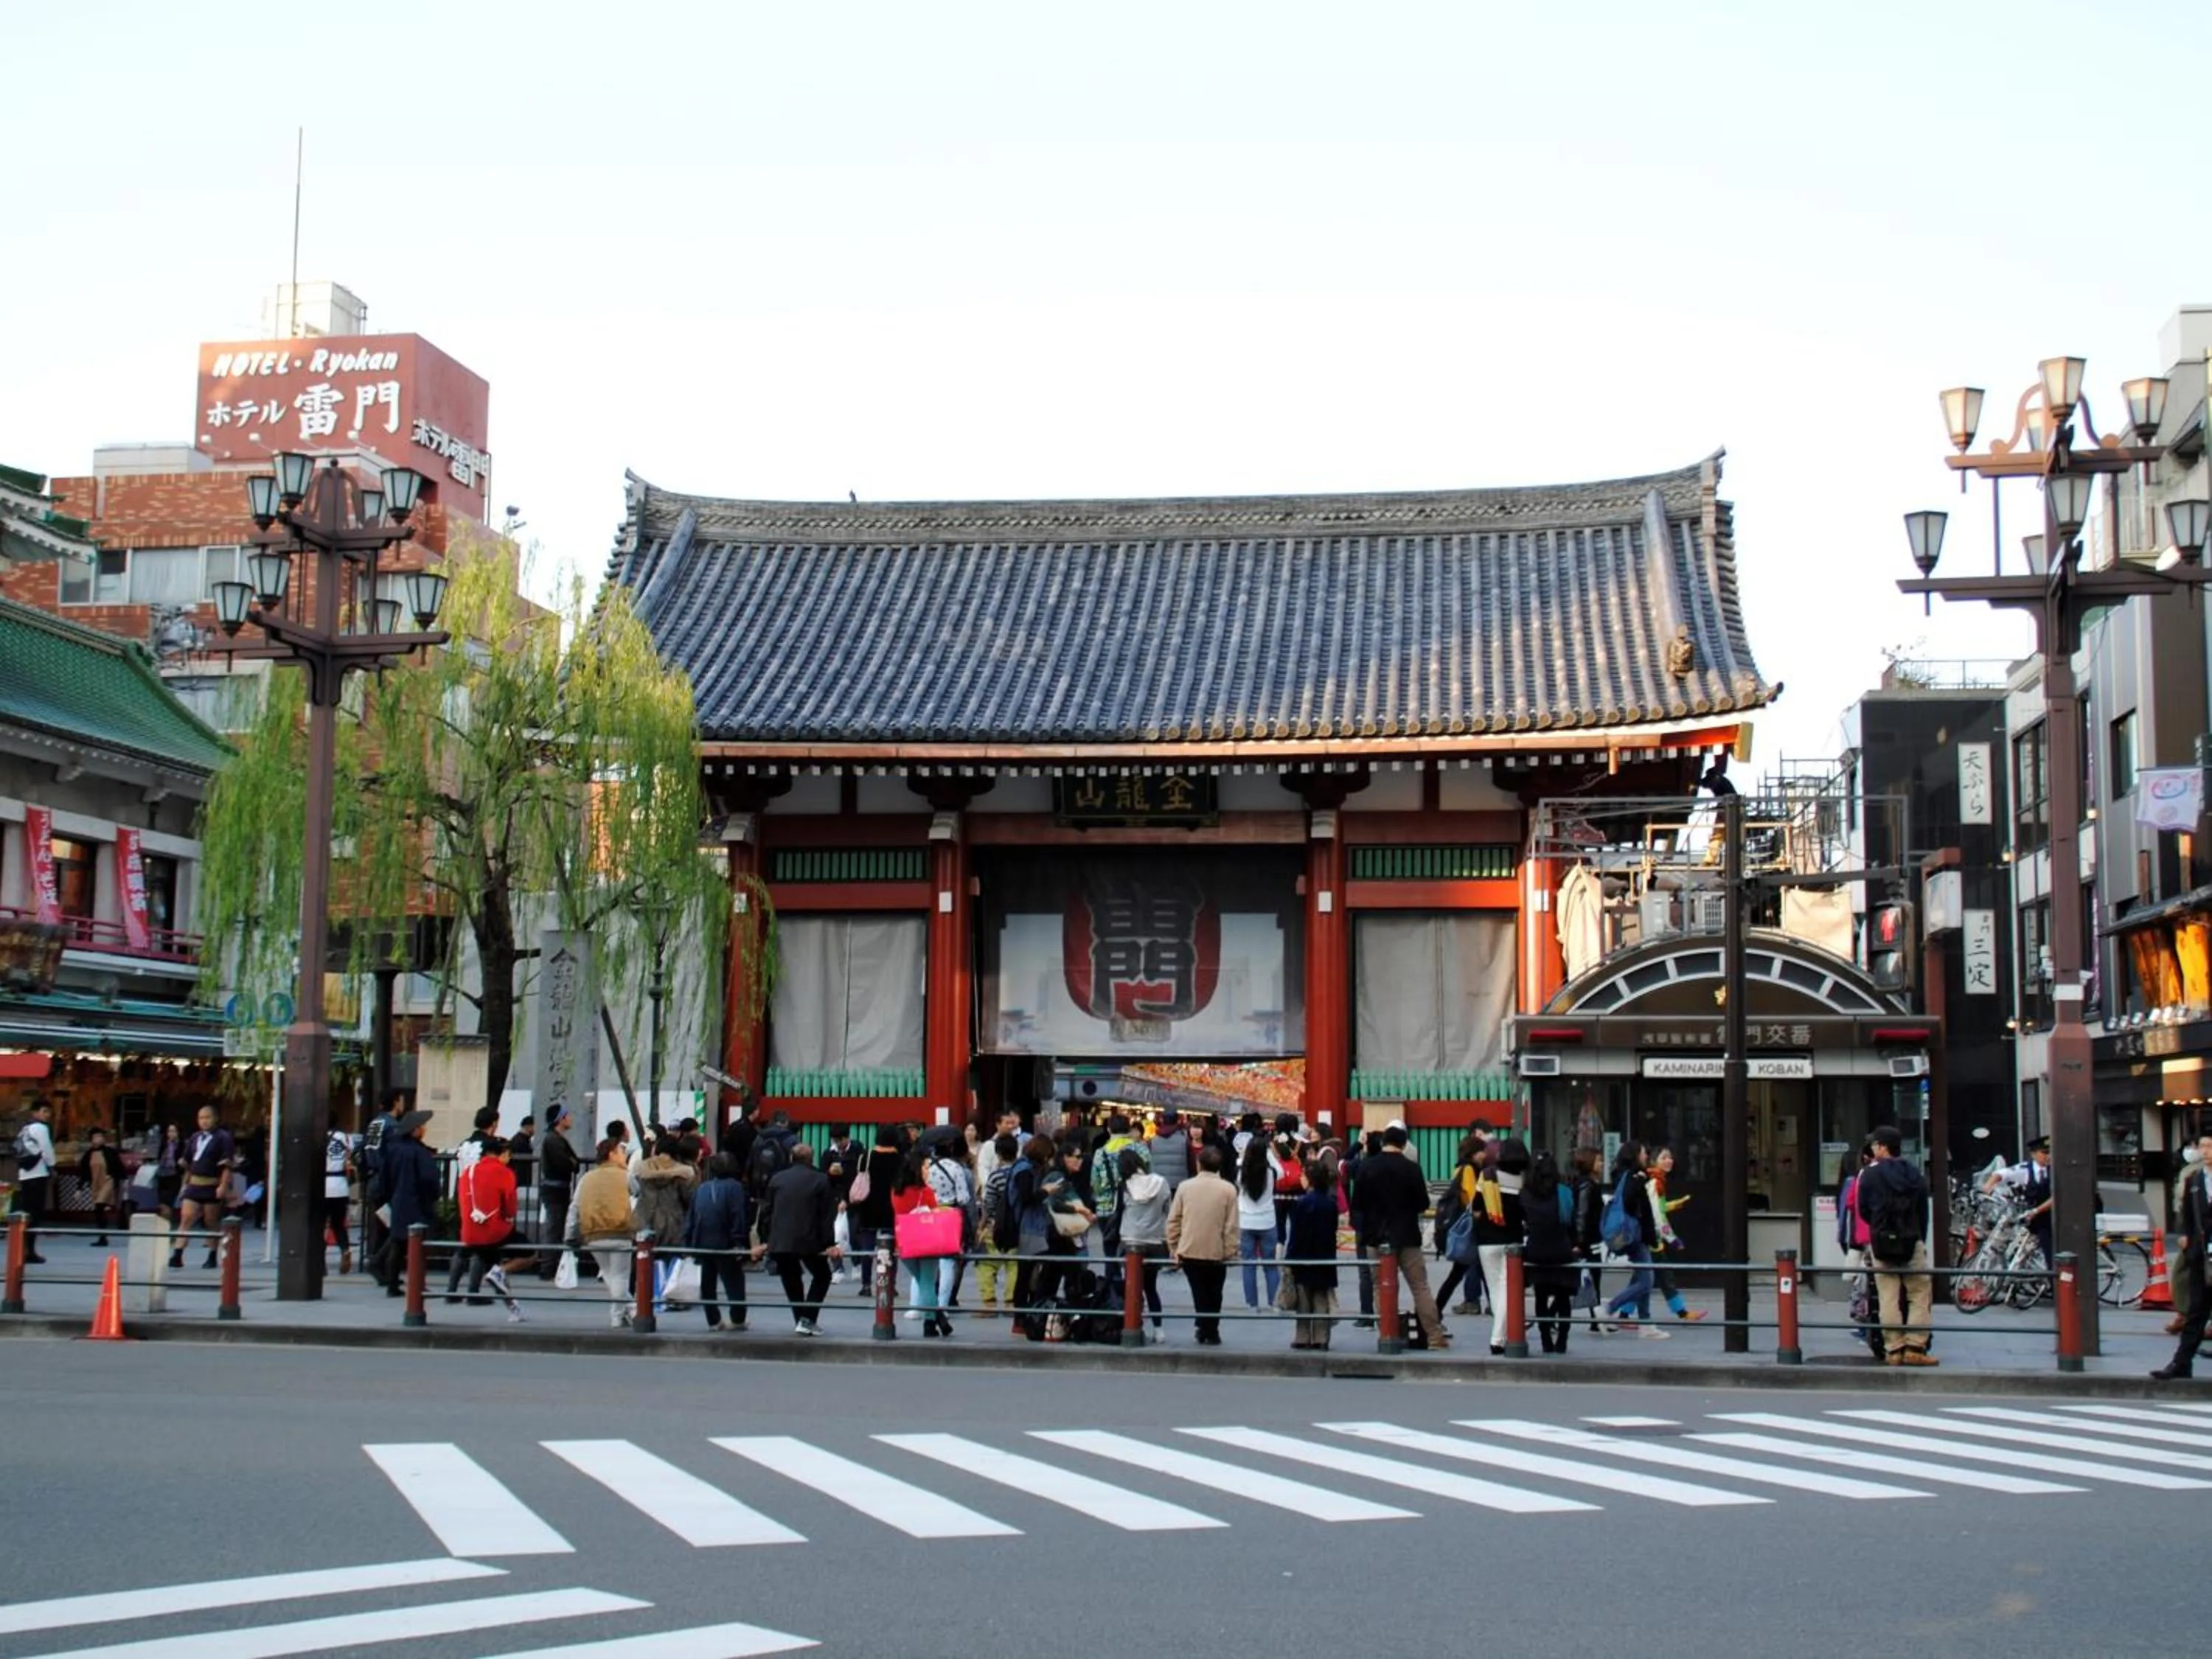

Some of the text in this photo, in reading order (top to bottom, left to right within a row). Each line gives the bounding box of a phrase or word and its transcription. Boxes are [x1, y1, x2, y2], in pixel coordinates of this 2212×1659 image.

[212, 348, 399, 378] HOTEL Ryokan
[1963, 751, 1984, 815] 天ぷら
[1758, 1062, 1804, 1074] KOBAN
